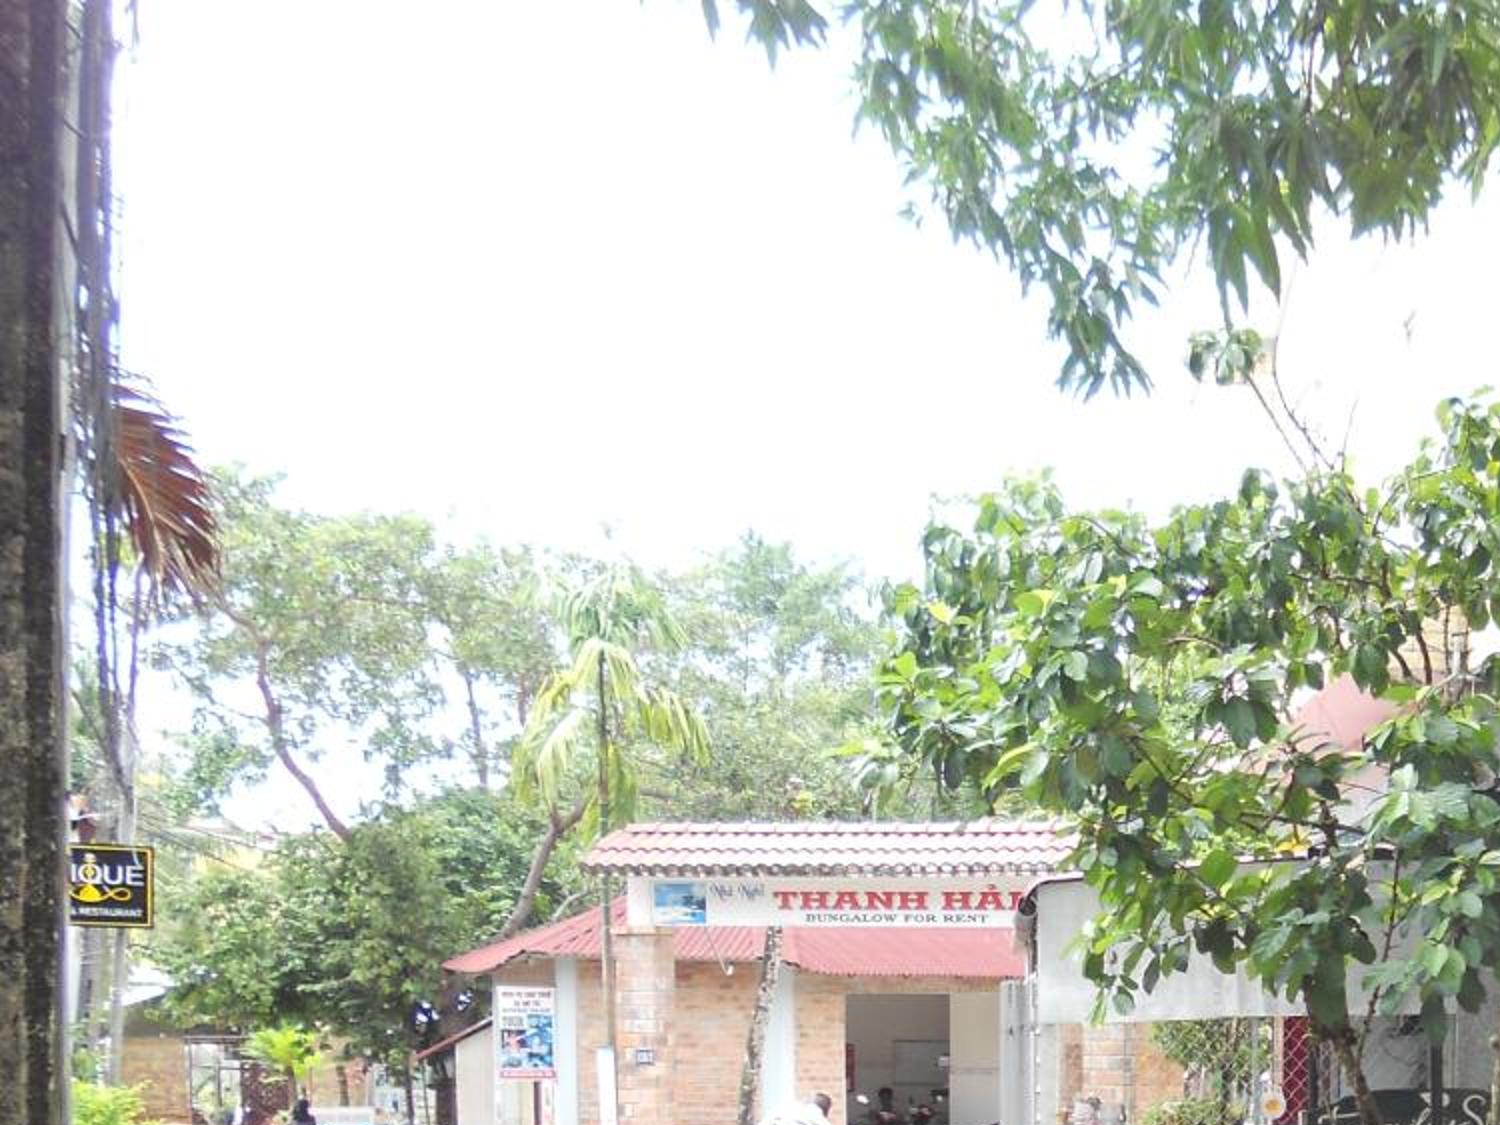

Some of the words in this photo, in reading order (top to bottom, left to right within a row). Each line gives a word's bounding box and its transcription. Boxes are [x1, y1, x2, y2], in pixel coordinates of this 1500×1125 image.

[773, 891, 929, 911] THANH
[805, 913, 897, 923] BUNGALOW
[904, 913, 937, 923] FOR
[943, 913, 990, 923] RENT
